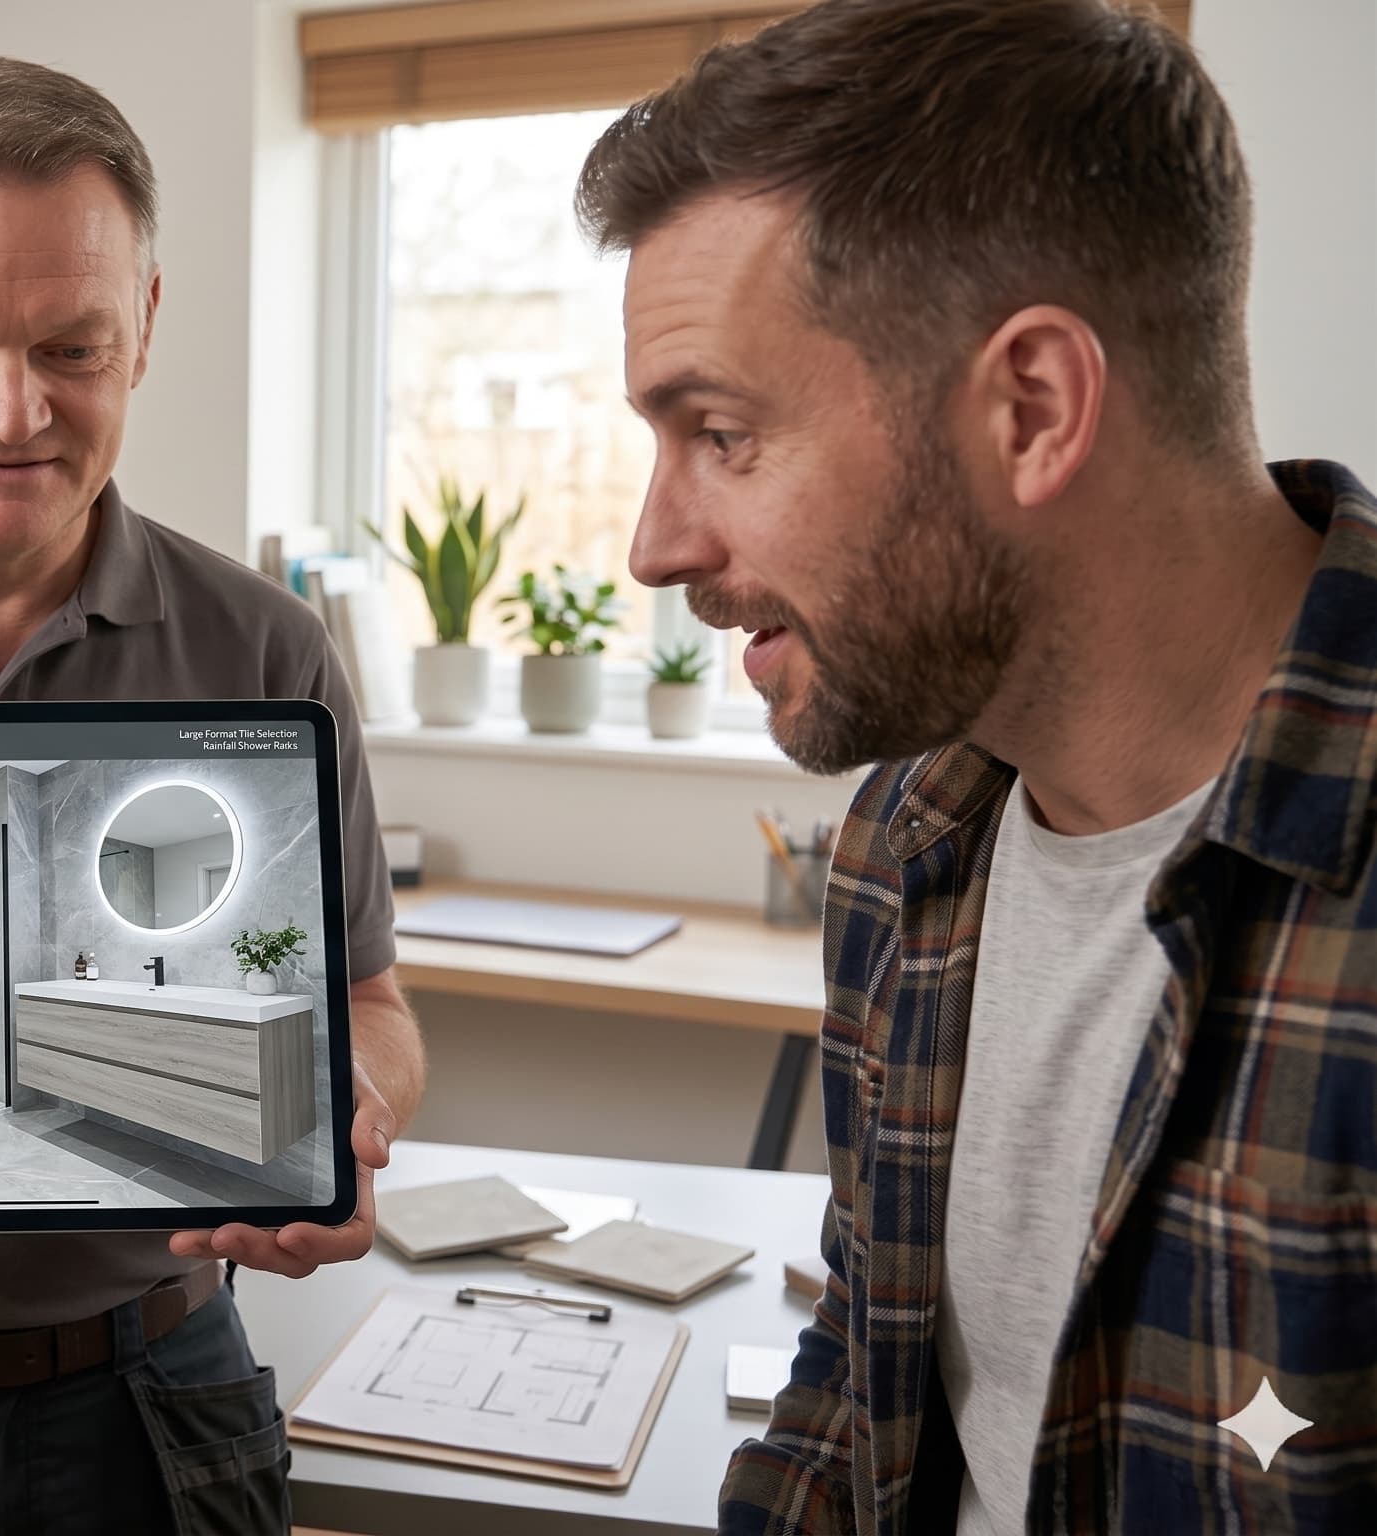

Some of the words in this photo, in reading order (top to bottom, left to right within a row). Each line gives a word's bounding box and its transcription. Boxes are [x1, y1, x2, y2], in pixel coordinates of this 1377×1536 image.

[179, 729, 204, 741] Large
[205, 729, 237, 739] Format
[203, 741, 237, 750] Rainfall
[238, 741, 272, 750] Shower
